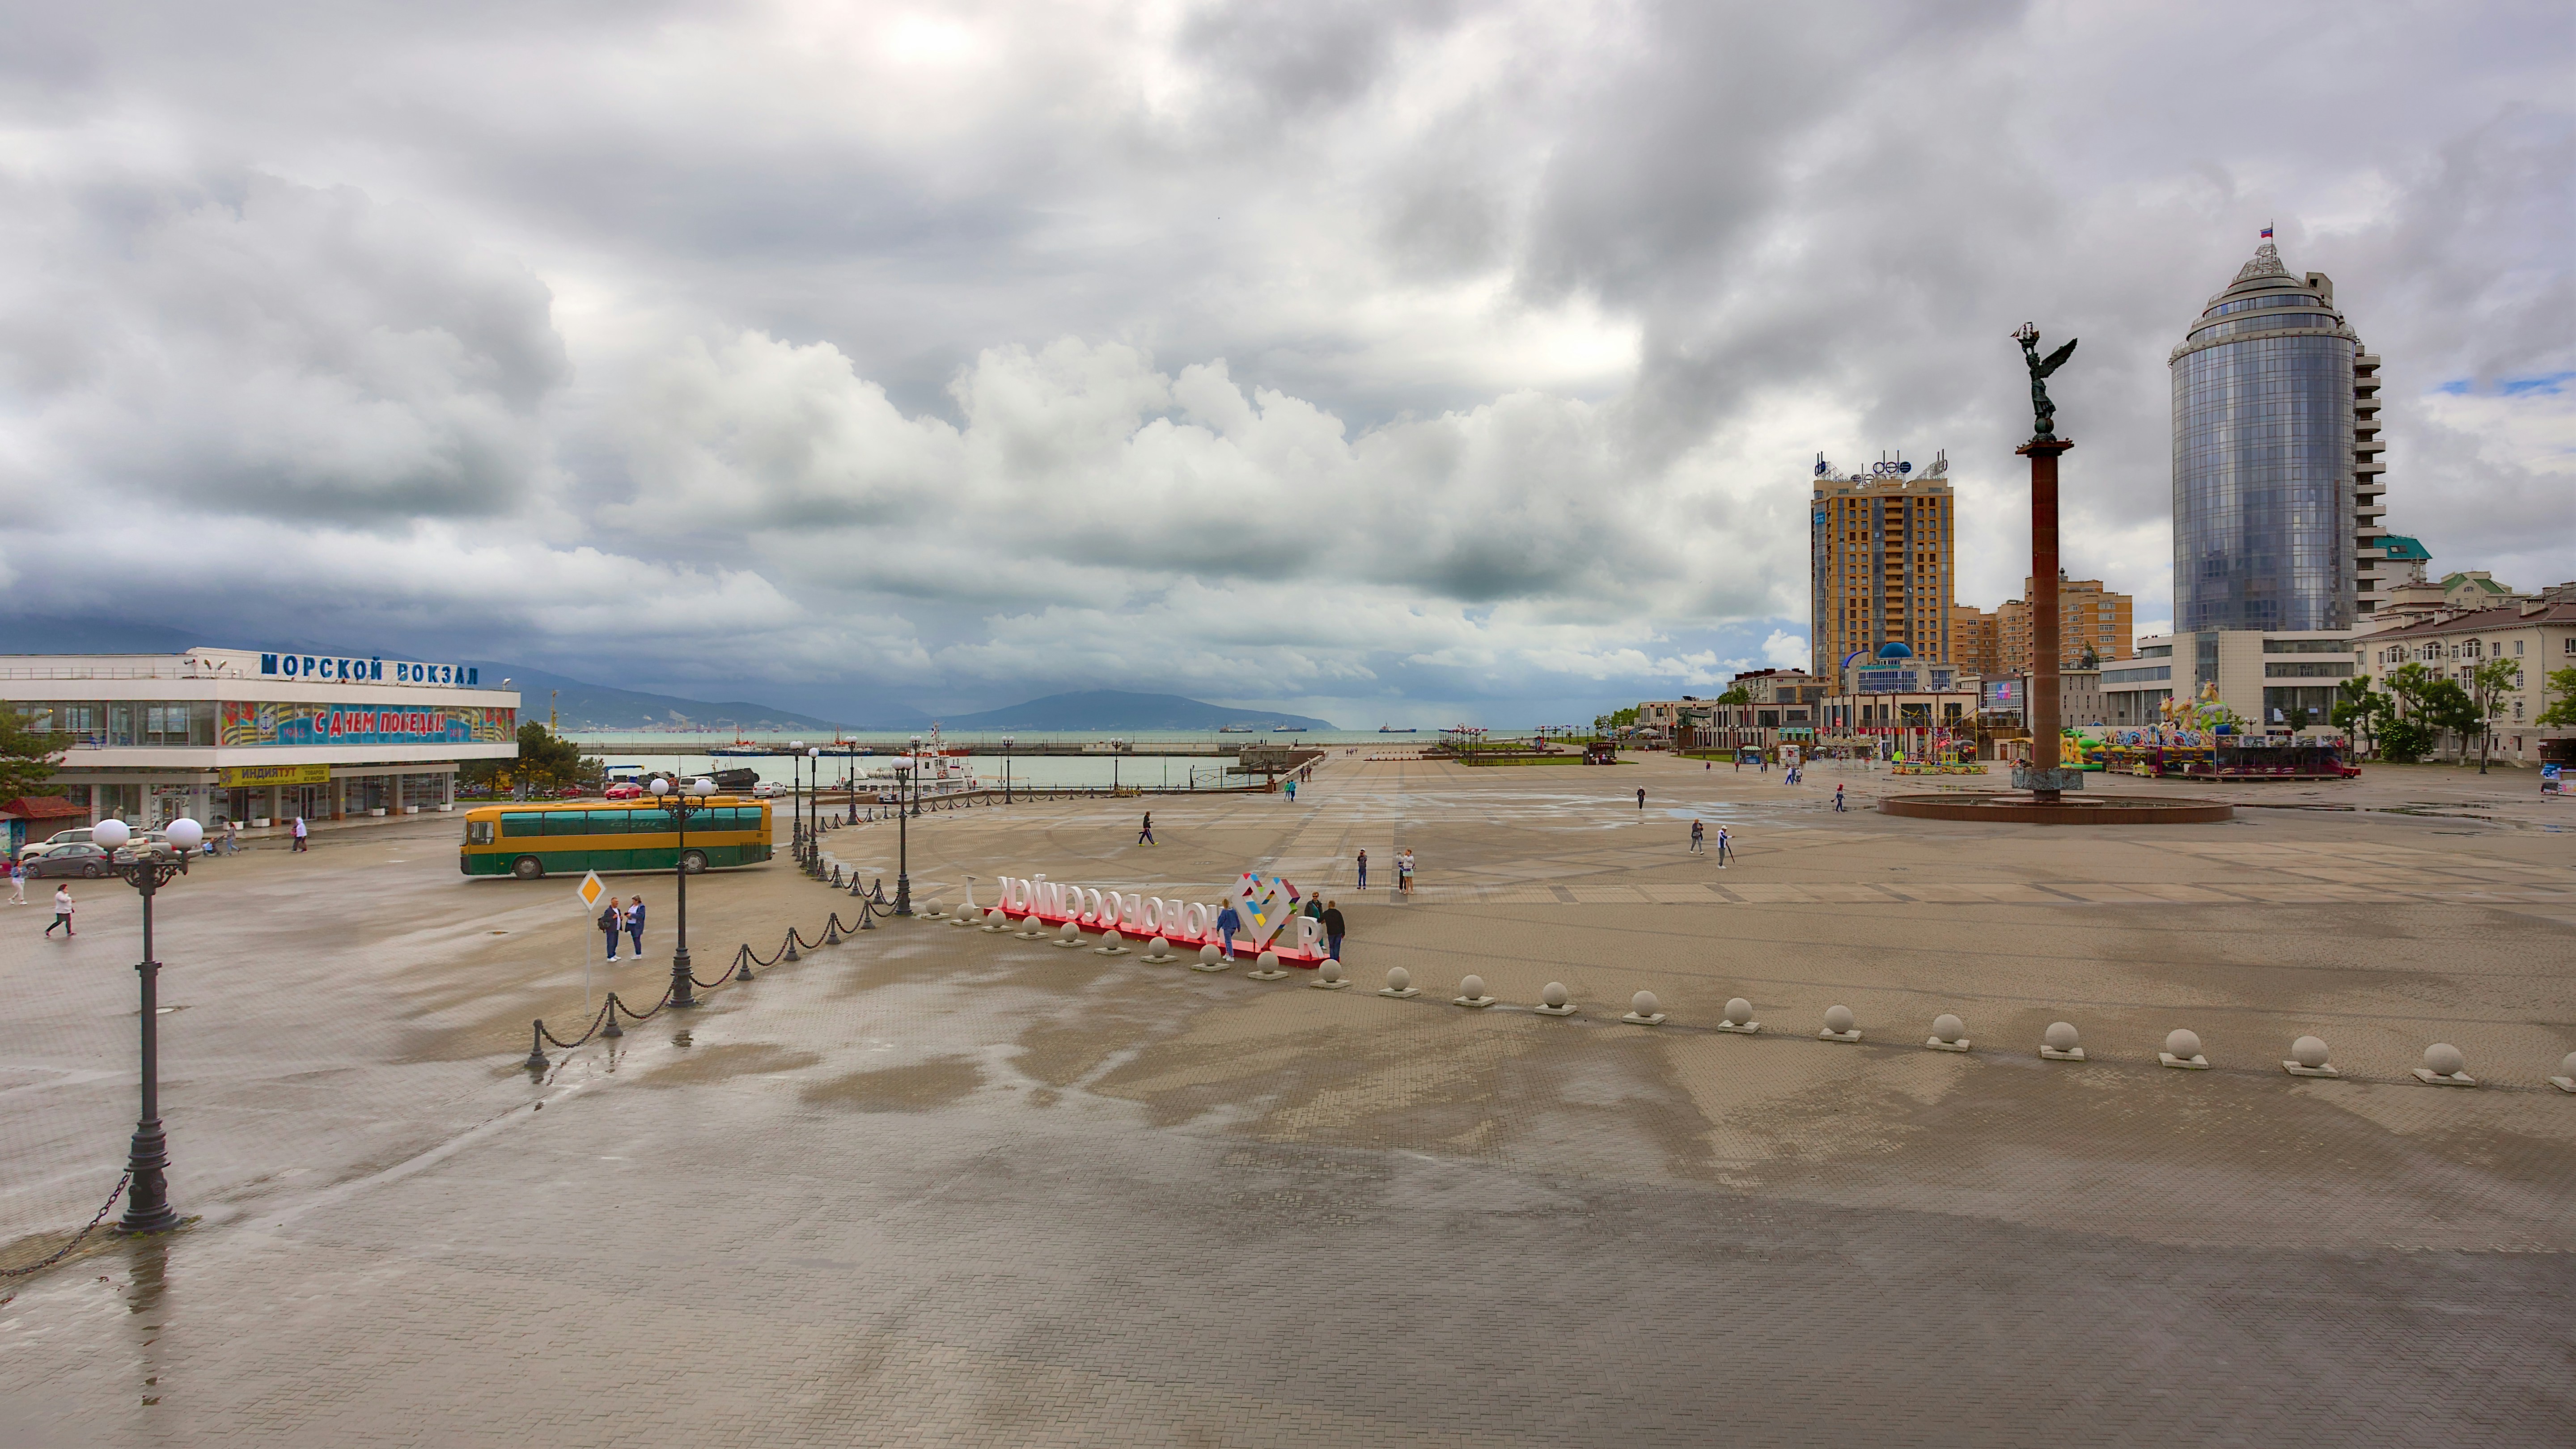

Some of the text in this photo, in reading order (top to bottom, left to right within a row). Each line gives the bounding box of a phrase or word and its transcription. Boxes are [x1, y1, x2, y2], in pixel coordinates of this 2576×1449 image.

[261, 654, 478, 685] МОРСКОЙ ВОКЗАЛ
[314, 711, 445, 737] С ДНЕМ ПОБЕДЫ!
